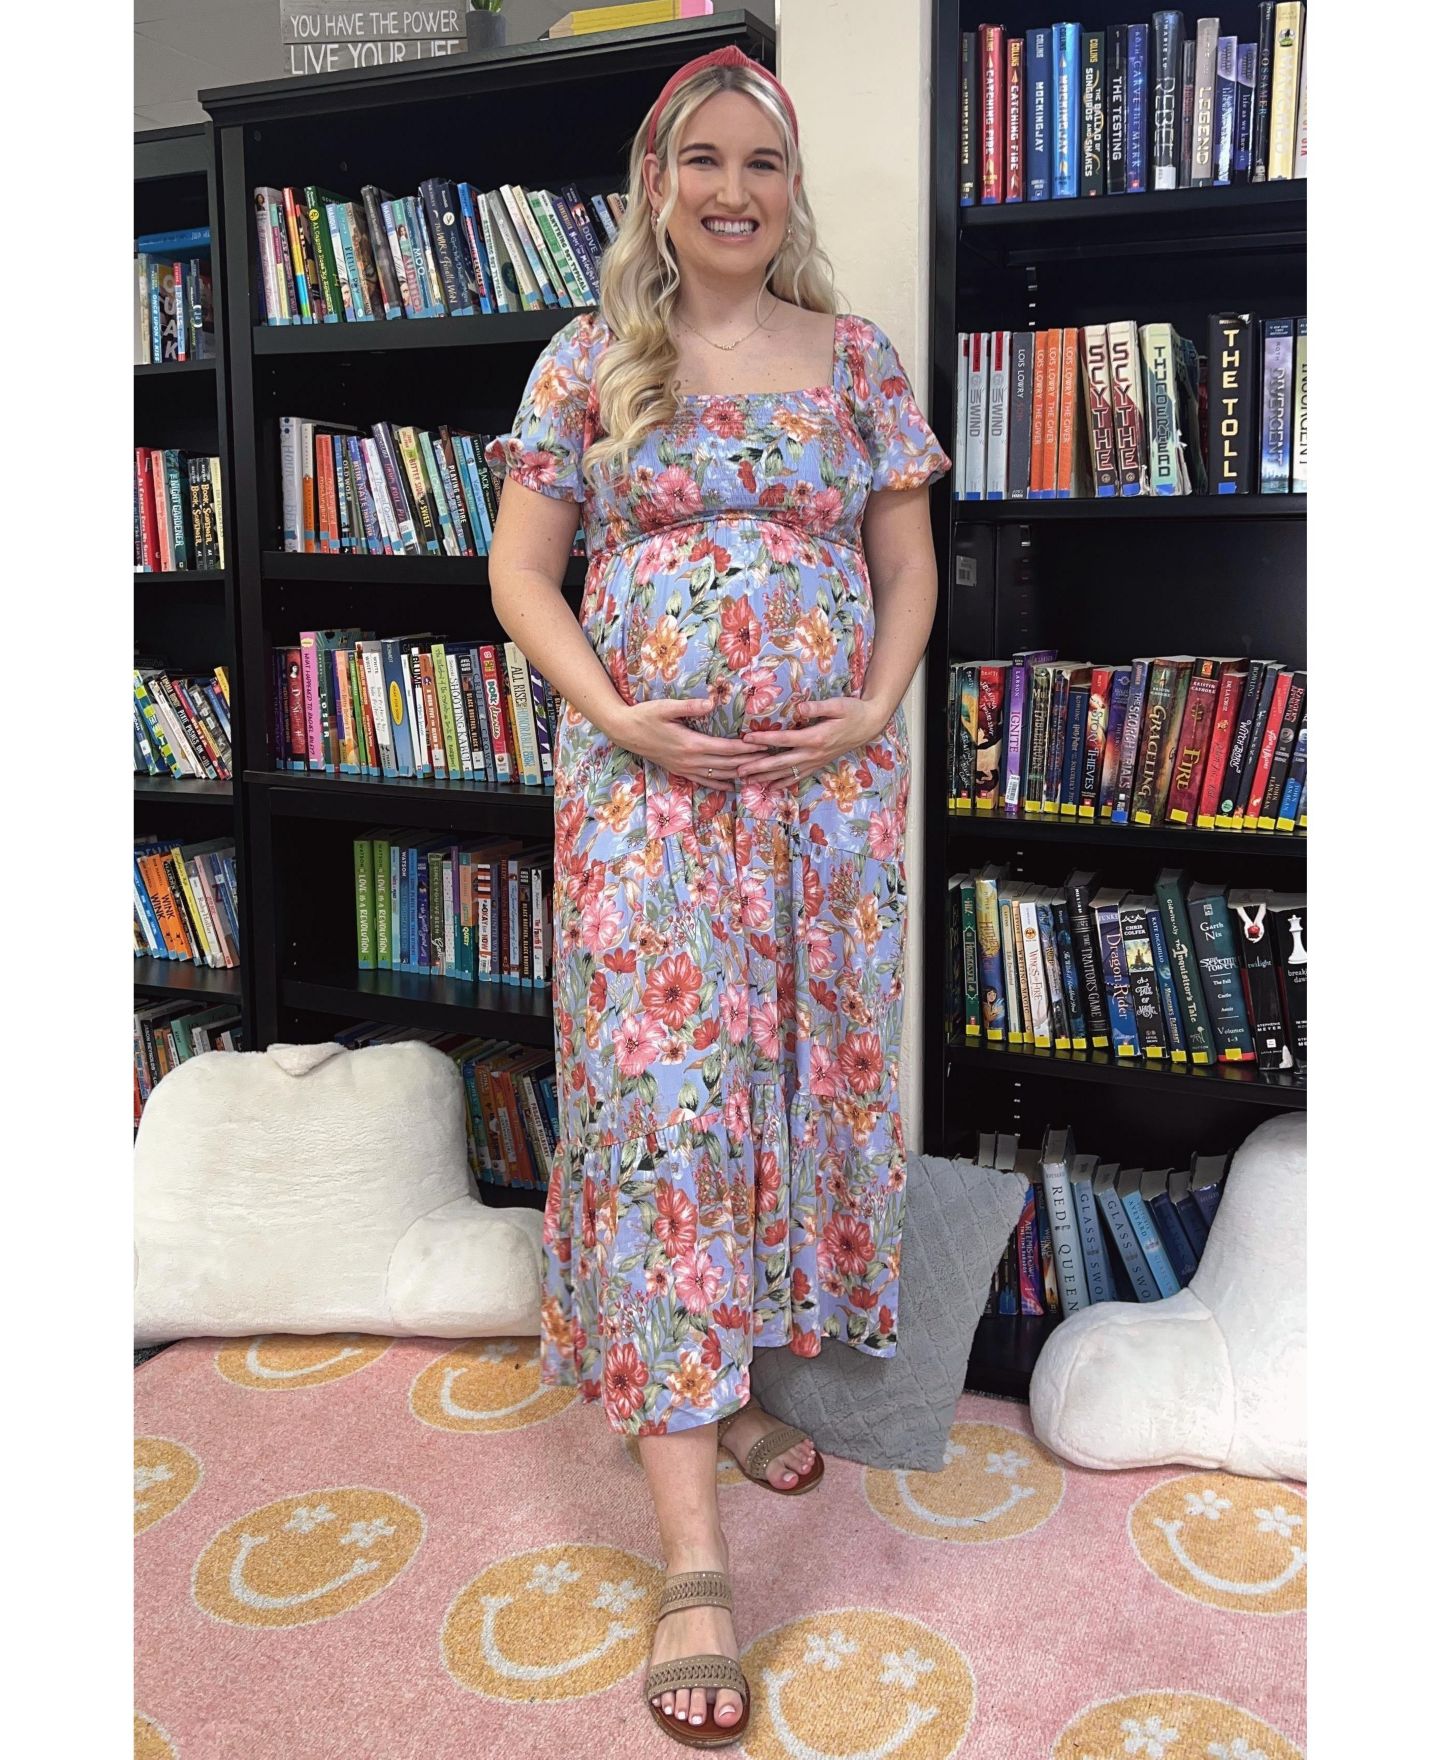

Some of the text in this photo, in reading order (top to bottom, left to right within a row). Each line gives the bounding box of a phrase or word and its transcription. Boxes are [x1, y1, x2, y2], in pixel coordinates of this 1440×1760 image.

[291, 10, 459, 38] YOU HAVE THE POWER
[290, 44, 339, 74] LIVE
[1090, 39, 1098, 62] COLLINS
[1010, 42, 1020, 170] COLLINS CATCHING FIRE
[1035, 34, 1044, 152] COLLINS MOCKINGJAY
[1258, 48, 1269, 118] GOSSAMER
[1275, 55, 1293, 154] MATCHED
[985, 70, 994, 155] CATCHING FIRE
[1059, 75, 1068, 154] MOCKINGJAY
[1112, 76, 1122, 160] THE TESTING
[1132, 60, 1142, 168] CARVE MARK
[1155, 77, 1175, 158] REBEL
[1197, 86, 1211, 164] LEGEND
[1240, 133, 1248, 152] knew
[327, 205, 336, 230] HADDIX
[382, 205, 393, 228] HADDIX
[437, 233, 447, 249] WAR
[582, 227, 598, 253] DOVE
[413, 248, 425, 275] MOO
[483, 220, 502, 299] ANYTHING TYPICAL
[549, 213, 586, 291] ANYTHING TYPICAL
[1089, 344, 1113, 471] SCYTHE
[1113, 342, 1137, 469] SCYTHE
[1154, 346, 1171, 477] THUNDERHEAD
[1222, 330, 1240, 478] THE TOLL
[1269, 367, 1285, 465] DIVERGENT
[353, 461, 366, 507] BETTER NATE
[448, 465, 460, 492] PLAYING
[474, 440, 489, 489] SHURTLIFF JACK
[171, 480, 184, 548] NIGHT GARDENER
[409, 458, 431, 528] BITTER SIDE SWEET
[412, 656, 422, 688] BLUME
[321, 693, 329, 737] LOSER
[449, 678, 469, 762] SHOOTING KABUL
[473, 673, 492, 769] CRUEL CROWN
[511, 666, 532, 750] ALL RISE HONORABLE
[1009, 711, 1020, 752] IGNITE
[186, 725, 197, 745] PUSHES
[1085, 710, 1103, 789] STORY THIEVES
[1119, 692, 1142, 788] THE SCORCH TRIALS
[1138, 705, 1166, 797] GRACELING
[1176, 746, 1201, 791] FIRE
[1264, 776, 1276, 810] FLANAGAN
[1283, 778, 1296, 811] FLANAGAN
[164, 862, 175, 890] HADDIX
[151, 893, 165, 920] WINK
[162, 894, 175, 920] WINK
[198, 897, 211, 934] Ruby Holler
[358, 875, 368, 953] LOVE REVOLUTION
[377, 875, 387, 953] LOVE REVOLUTION
[1200, 922, 1223, 932] Garth
[1205, 932, 1222, 941] Nix
[1248, 956, 1272, 968] twilight
[1021, 988, 1029, 1014] MAGIC
[1029, 949, 1042, 1001] WINGS FIRE
[1081, 947, 1101, 1017] TRAITOR'S GAME
[1106, 934, 1129, 1020] Dragon Rider
[1173, 949, 1192, 1001] Inquisitor's
[147, 1042, 155, 1070] REYNOLDS
[1169, 1017, 1180, 1043] ELEPHANT
[531, 1103, 548, 1157] PROJECT MULBERRY
[1025, 1221, 1034, 1254] ARTEMIS
[1080, 1194, 1095, 1244] GLASS
[1107, 1201, 1132, 1249] GLASS
[1052, 1186, 1078, 1312] RED QUEEN
